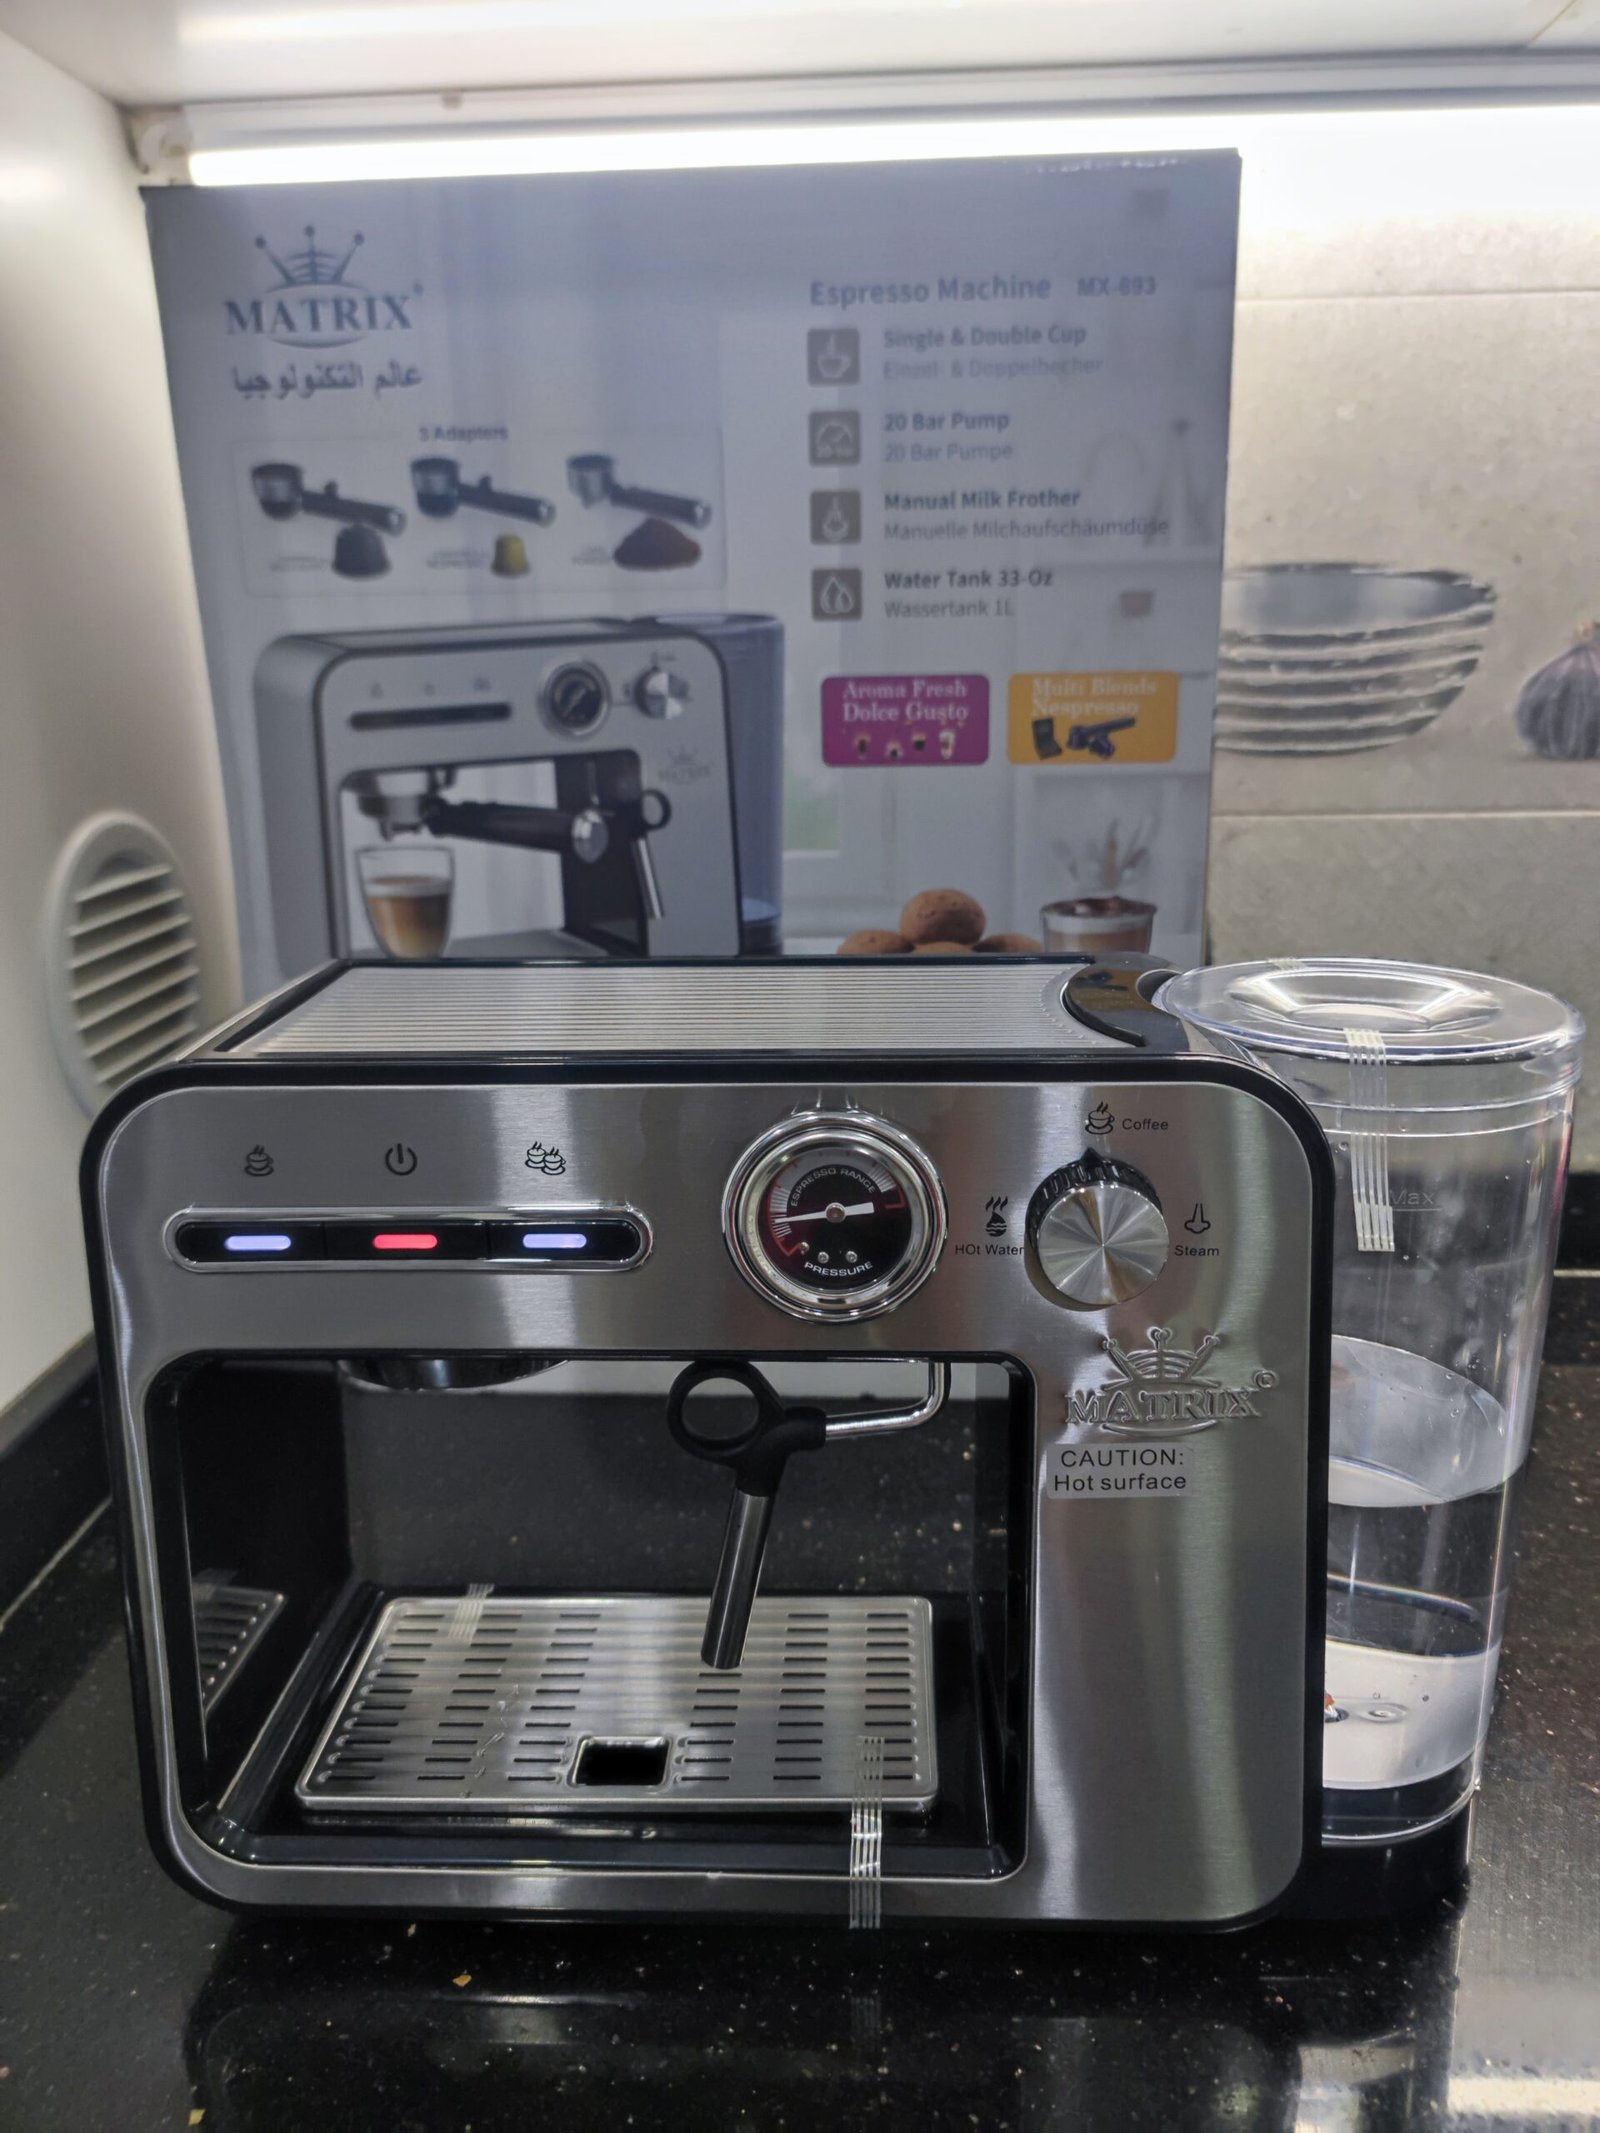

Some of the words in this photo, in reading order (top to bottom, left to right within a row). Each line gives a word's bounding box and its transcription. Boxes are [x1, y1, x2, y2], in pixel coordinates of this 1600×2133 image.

[810, 280, 929, 310] Espresso
[937, 276, 1052, 301] Machine
[225, 294, 412, 335] MATRIX
[883, 328, 944, 351] Single
[950, 328, 964, 346] &
[971, 324, 1042, 346] Double
[1048, 324, 1087, 348] Cup
[374, 358, 422, 400] عالم
[883, 414, 907, 433] 20
[913, 414, 946, 432] Bar
[951, 411, 1010, 433] Pump
[884, 445, 907, 463] 20
[912, 444, 945, 462] Bar
[951, 441, 1014, 464] Pumpe
[884, 491, 956, 511] Manual
[961, 491, 1001, 509] Milk
[1007, 489, 1081, 508] Frother
[884, 520, 967, 541] Manuelle
[884, 571, 940, 590] Water
[946, 569, 991, 588] Tank
[998, 568, 1054, 587] 33-Oz
[884, 597, 988, 619] Wassertank
[843, 681, 905, 699] Aroma
[912, 677, 968, 698] Fresh
[843, 701, 898, 722] Dolce
[906, 701, 969, 722] Gusto
[1122, 1118, 1169, 1131] Coffee
[791, 1167, 837, 1207] ESPRESSO
[840, 1168, 876, 1194] RANGE
[985, 1244, 1025, 1255] Water
[1174, 1244, 1219, 1257] Steam
[804, 1261, 873, 1277] PRESSURE
[1065, 1387, 1264, 1424] MATRIX
[1061, 1449, 1184, 1467] CAUTION:
[1054, 1474, 1094, 1492] Hot
[1101, 1473, 1187, 1491] surface
